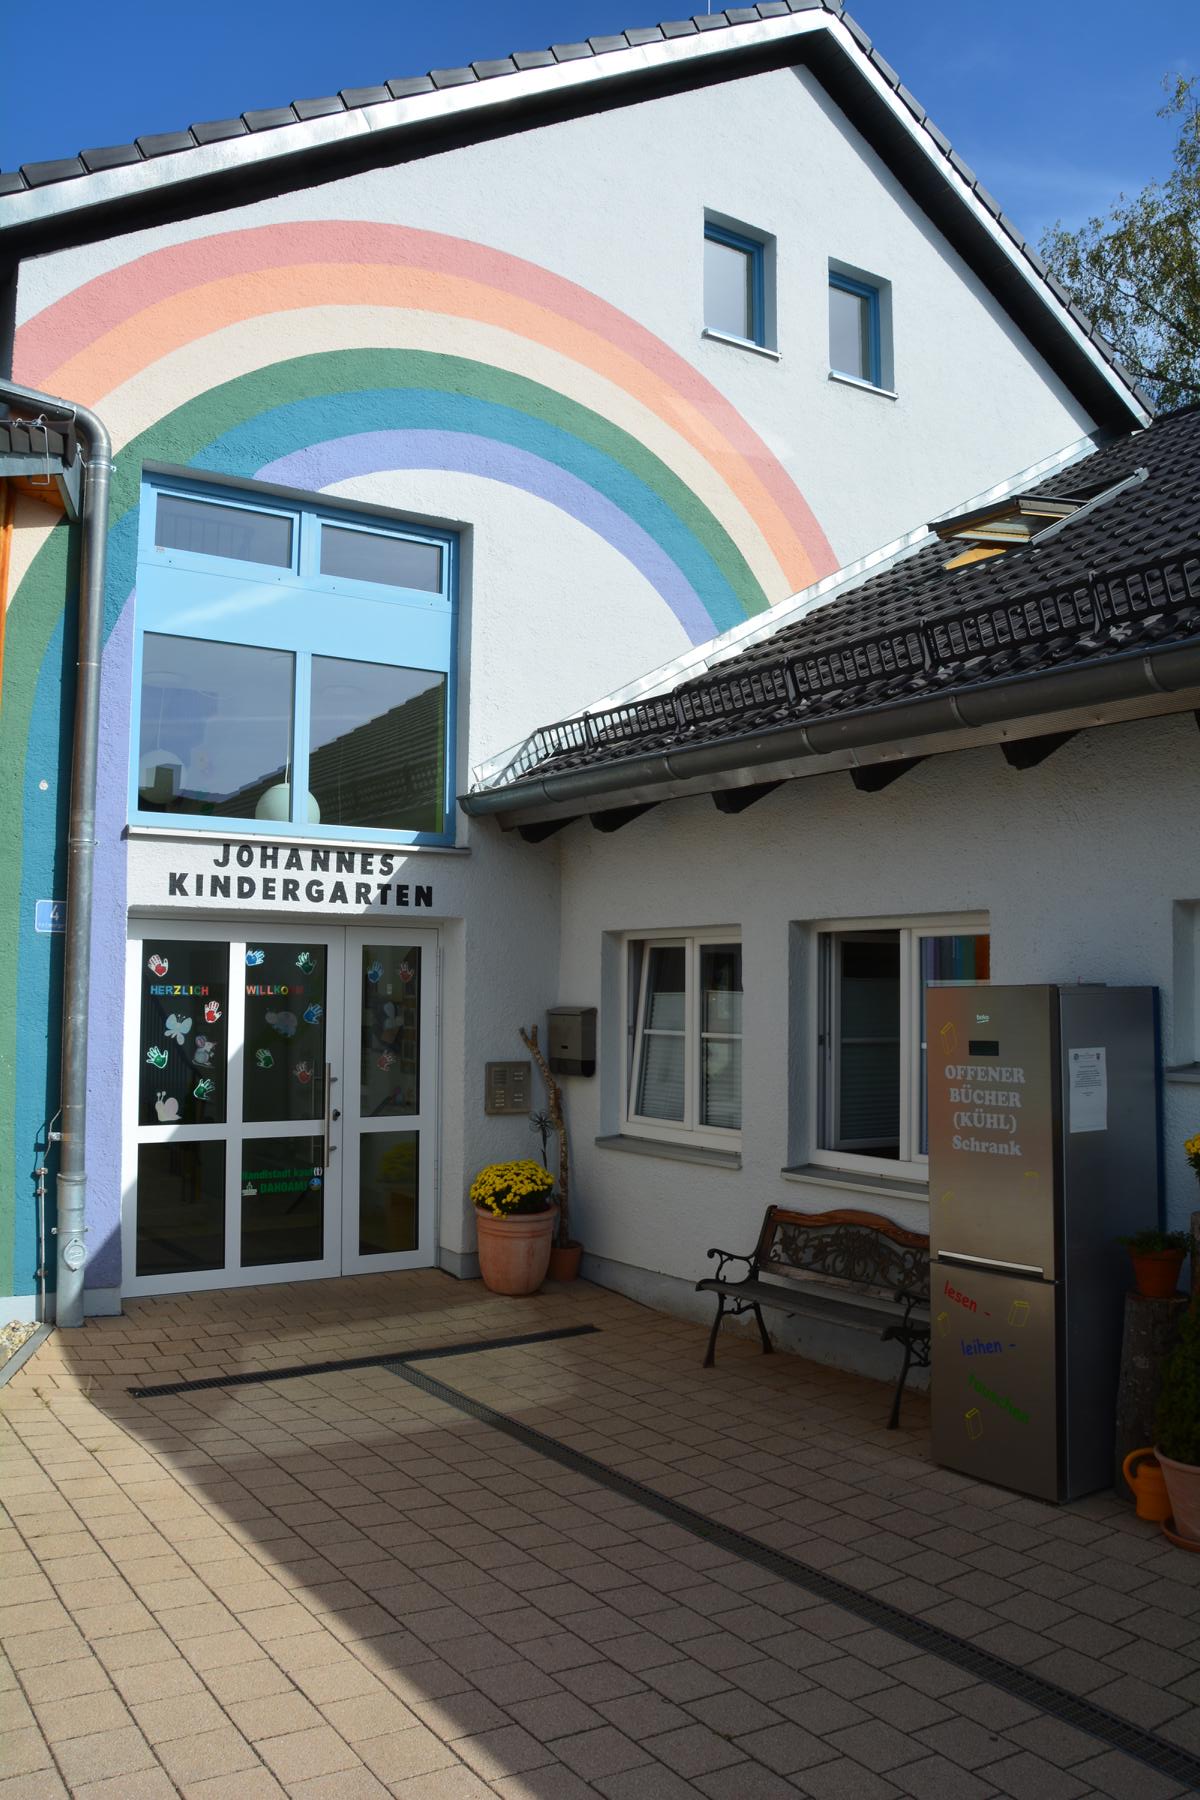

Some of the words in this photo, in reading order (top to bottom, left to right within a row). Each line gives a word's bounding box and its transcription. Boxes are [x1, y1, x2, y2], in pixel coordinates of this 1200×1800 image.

[213, 844, 395, 876] JOHANNES
[168, 872, 433, 908] KINDERGARTEN
[49, 904, 60, 921] 4
[150, 985, 209, 996] HERZLICH
[944, 1065, 1026, 1084] OFFENER
[949, 1084, 1022, 1108] BÜCHER
[953, 1108, 1017, 1134] (KÜHL)
[952, 1135, 1023, 1156] Schrank
[943, 1280, 977, 1313] lesen
[961, 1338, 1002, 1356] leihen
